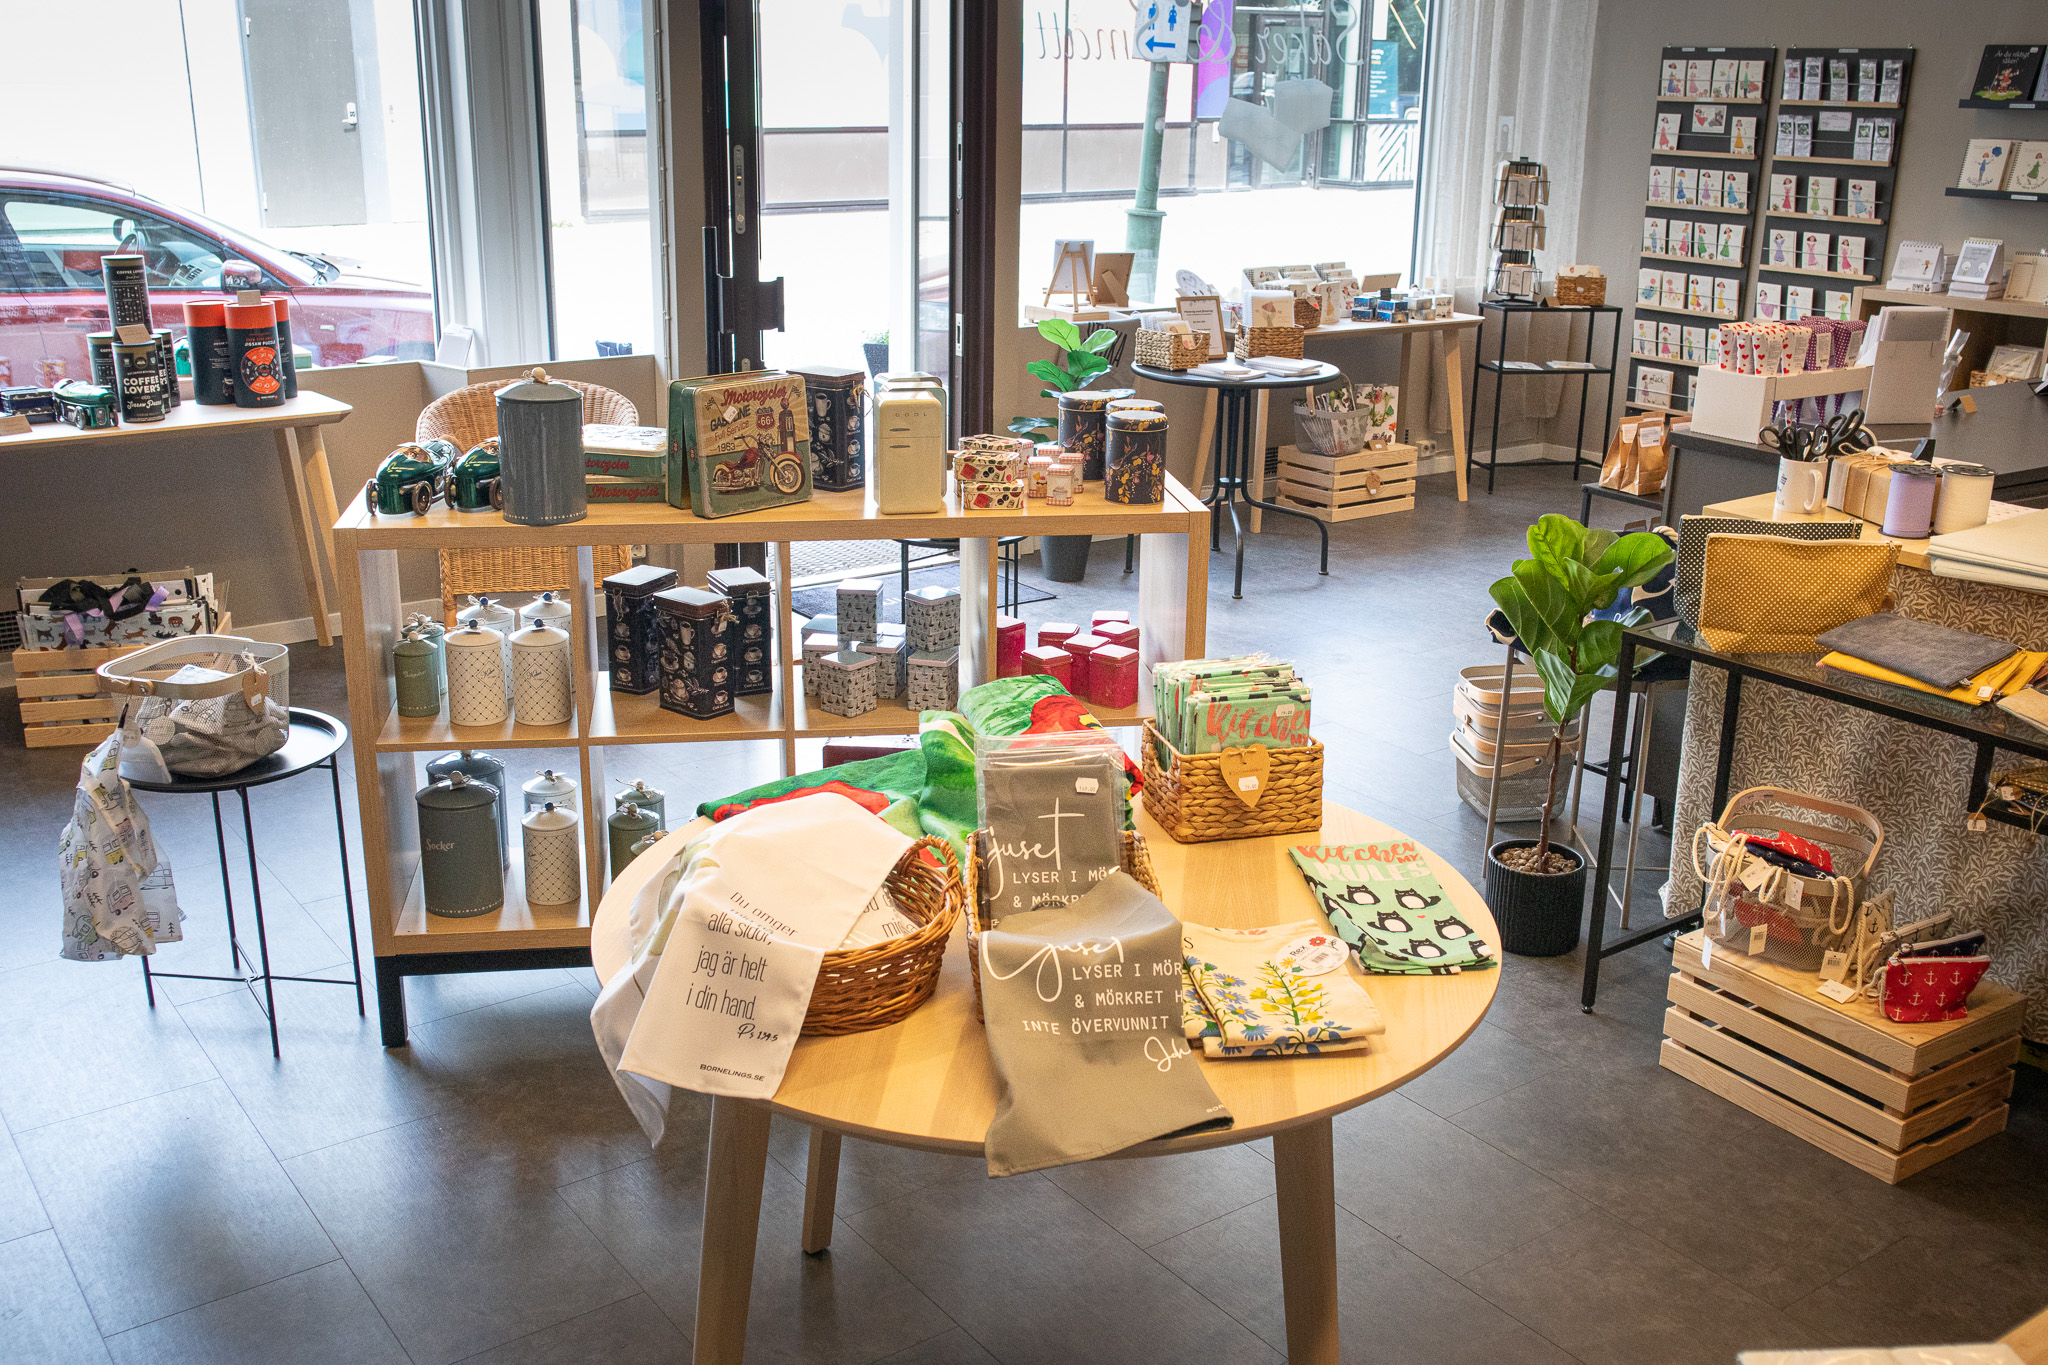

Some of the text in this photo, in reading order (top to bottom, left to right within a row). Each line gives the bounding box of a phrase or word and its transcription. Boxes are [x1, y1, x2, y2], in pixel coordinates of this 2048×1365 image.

[123, 375, 160, 386] COFFEE
[123, 383, 161, 394] LOVER'S
[720, 384, 788, 406] Motorcycles
[710, 404, 751, 432] GASINE
[760, 416, 771, 426] 66
[726, 420, 750, 437] Service
[717, 443, 736, 453] 1963
[585, 457, 630, 473] torcycles
[426, 839, 455, 852] Socker
[987, 797, 1085, 900] juset
[1013, 866, 1108, 884] LYSER I MÖ
[1313, 860, 1432, 882] RULES
[1013, 895, 1022, 908] &
[707, 911, 734, 935] alla
[730, 891, 750, 909] Du
[752, 907, 798, 936] omger
[692, 945, 768, 982] jag är helt
[1072, 959, 1183, 981] LYSER I MÖR
[685, 982, 757, 1021] i din hand.
[1074, 993, 1085, 1009] &
[1095, 989, 1164, 1007] MÖRKRET
[737, 1022, 755, 1039] Ps
[1022, 1019, 1061, 1036] INTE
[1071, 1016, 1170, 1035] ÖVERVUNNIT
[699, 1063, 766, 1082] BORNELINGS.SE
